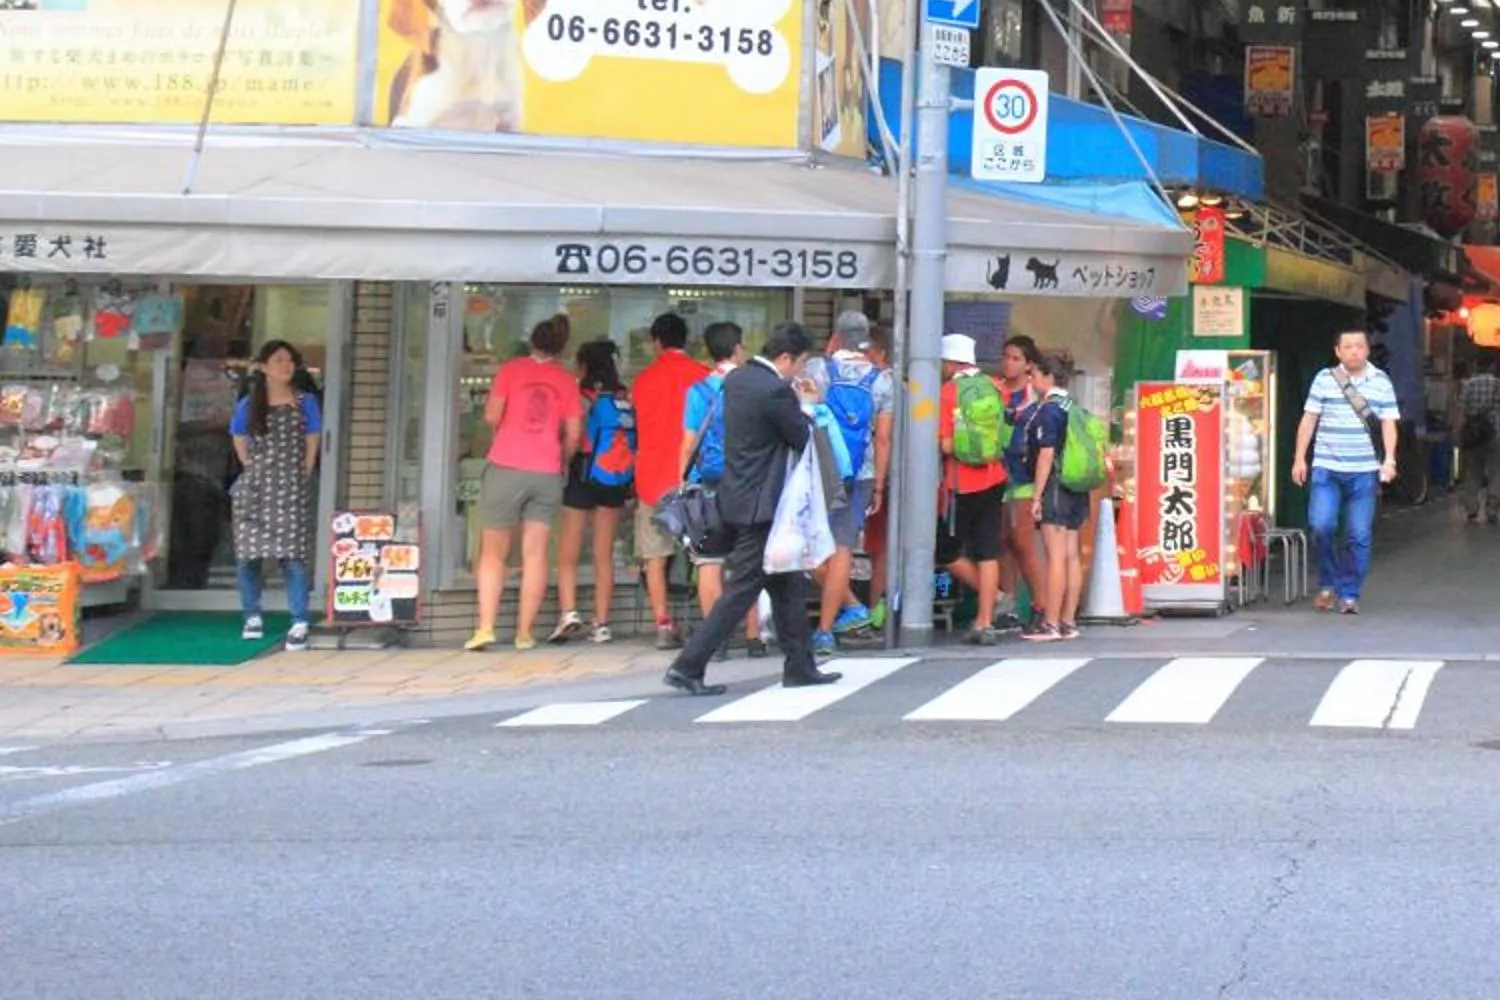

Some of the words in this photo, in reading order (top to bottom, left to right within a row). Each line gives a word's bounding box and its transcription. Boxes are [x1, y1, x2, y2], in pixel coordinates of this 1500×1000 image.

[548, 13, 774, 56] 06-6631-3158
[996, 94, 1026, 119] 30
[0, 233, 107, 259] 愛犬社
[596, 244, 858, 280] 06-6631-3158
[1072, 263, 1156, 289] ペットショップ
[1163, 416, 1194, 551] 黒門太郎
